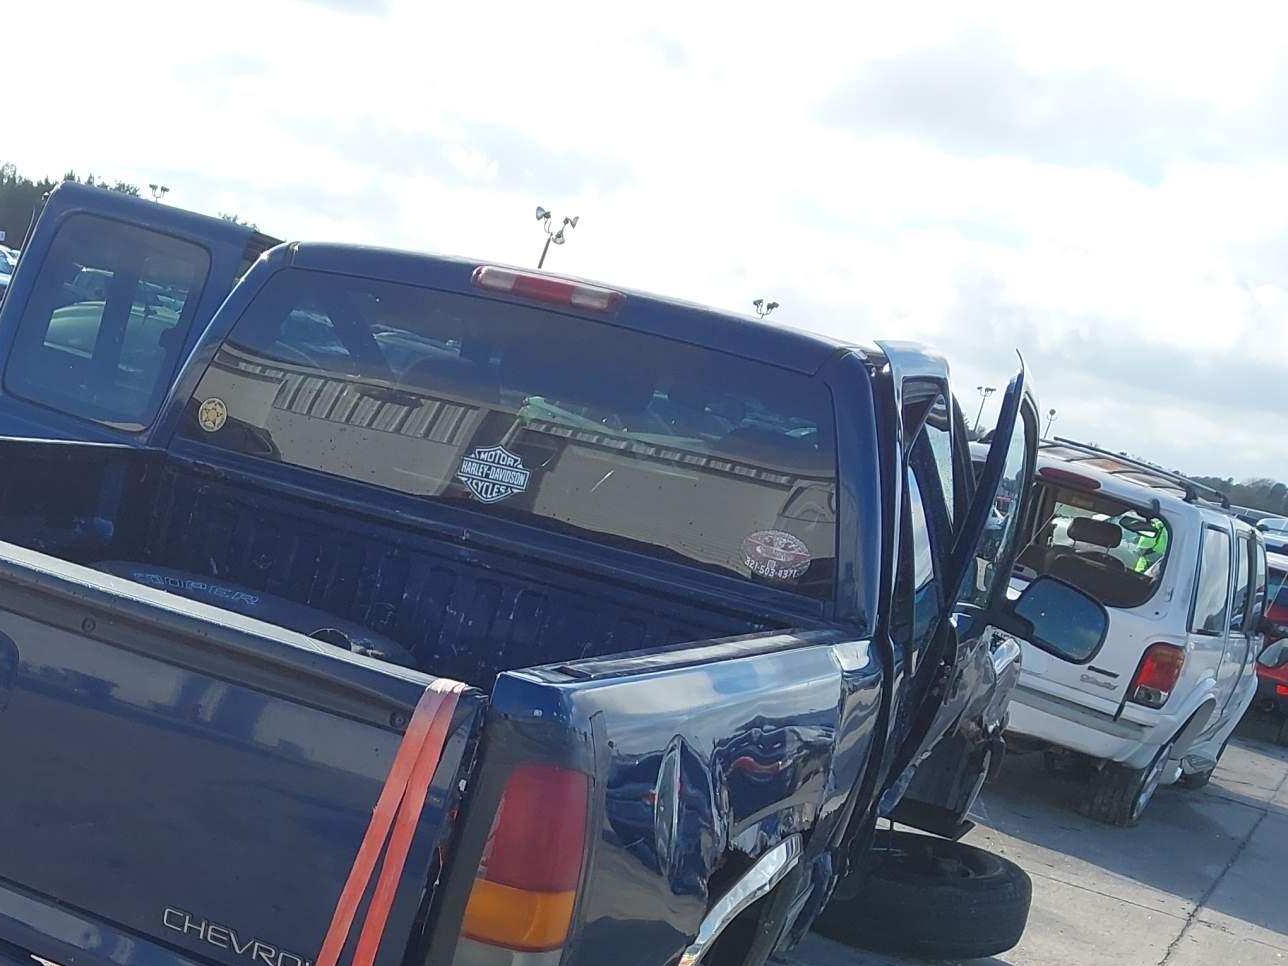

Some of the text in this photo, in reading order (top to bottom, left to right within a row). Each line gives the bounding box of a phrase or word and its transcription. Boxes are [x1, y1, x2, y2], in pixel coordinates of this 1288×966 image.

[480, 450, 518, 468] MOTOR
[461, 460, 526, 486] HARLEY-DAVIDSON
[472, 480, 507, 498] CYCLES
